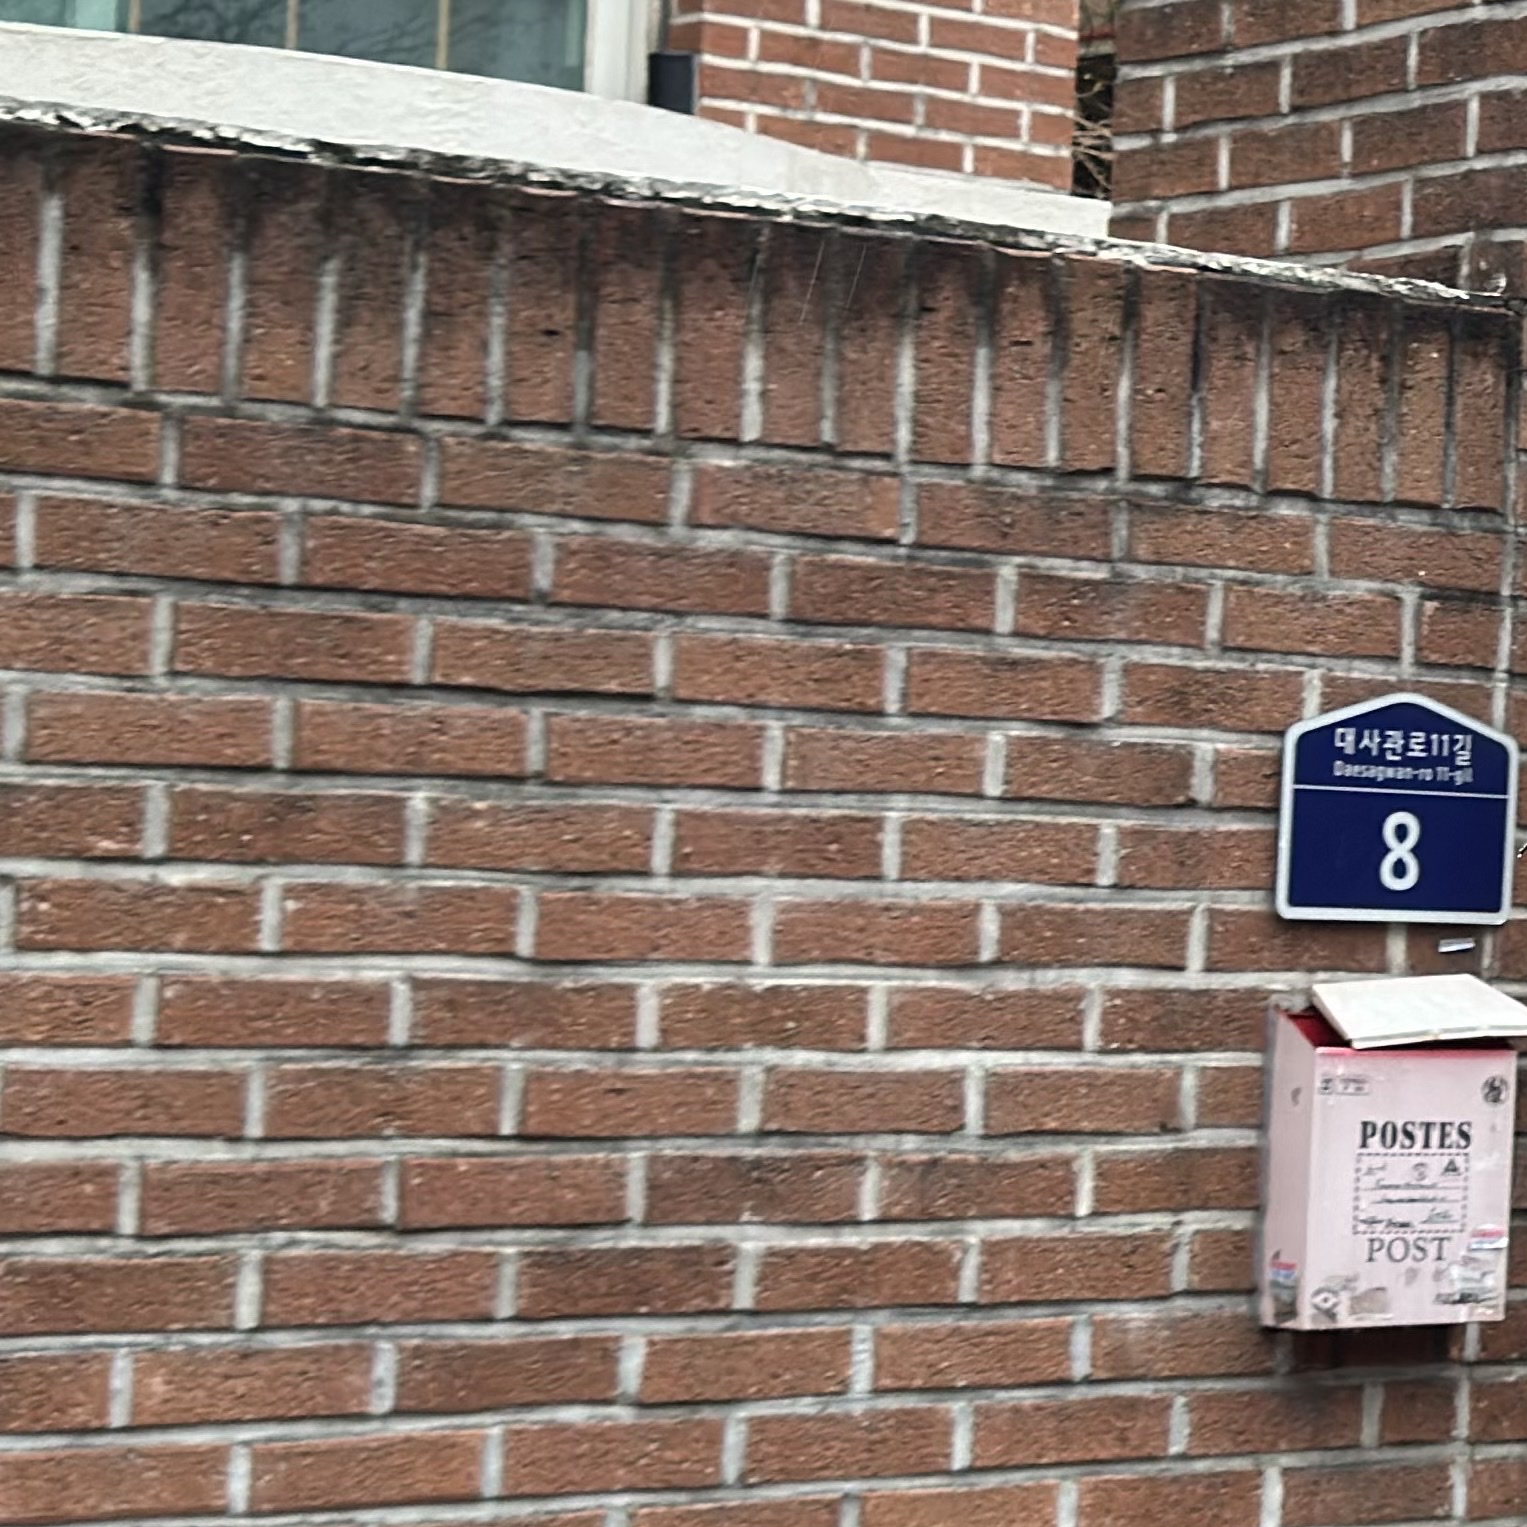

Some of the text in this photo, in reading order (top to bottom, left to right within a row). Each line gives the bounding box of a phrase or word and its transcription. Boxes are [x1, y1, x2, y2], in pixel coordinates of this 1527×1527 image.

[1334, 727, 1473, 766] 대사관로11길
[1333, 760, 1474, 786] Daesagwan-ro 11-gil
[1379, 811, 1421, 891] 8
[1359, 1120, 1473, 1150] POSTES
[1365, 1236, 1452, 1263] POST
